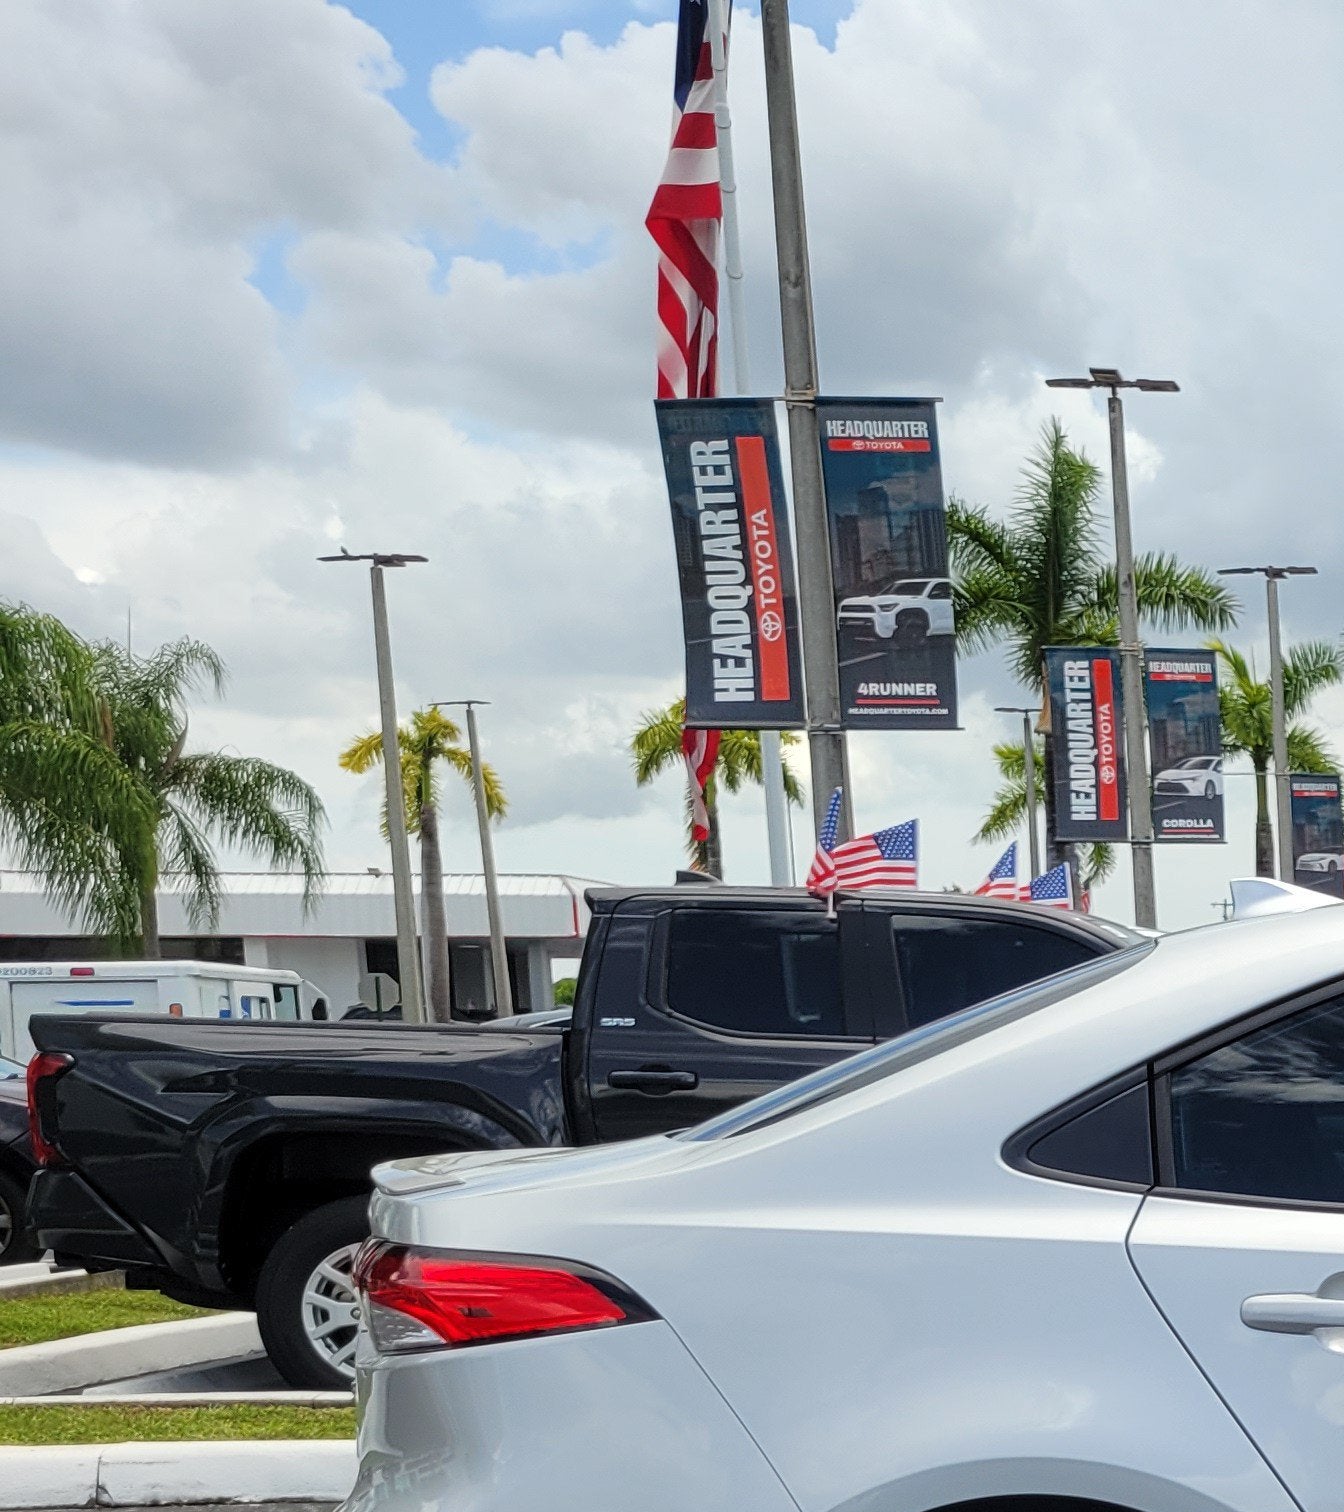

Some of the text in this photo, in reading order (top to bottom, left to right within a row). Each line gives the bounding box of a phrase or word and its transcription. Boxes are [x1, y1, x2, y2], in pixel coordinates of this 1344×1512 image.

[826, 420, 929, 439] HEADQUARTER
[866, 441, 904, 449] TOYOTA
[751, 509, 777, 608] TOYOTA
[690, 439, 753, 702] HEADQUARTER
[1149, 661, 1213, 674] HEADQUARTER
[857, 682, 938, 696] 4RUNNER
[1063, 659, 1098, 821] HEADQUARTER
[1099, 703, 1114, 764] TOYOTA
[1161, 819, 1214, 828] COROLLA
[600, 1017, 636, 1027] SR5
